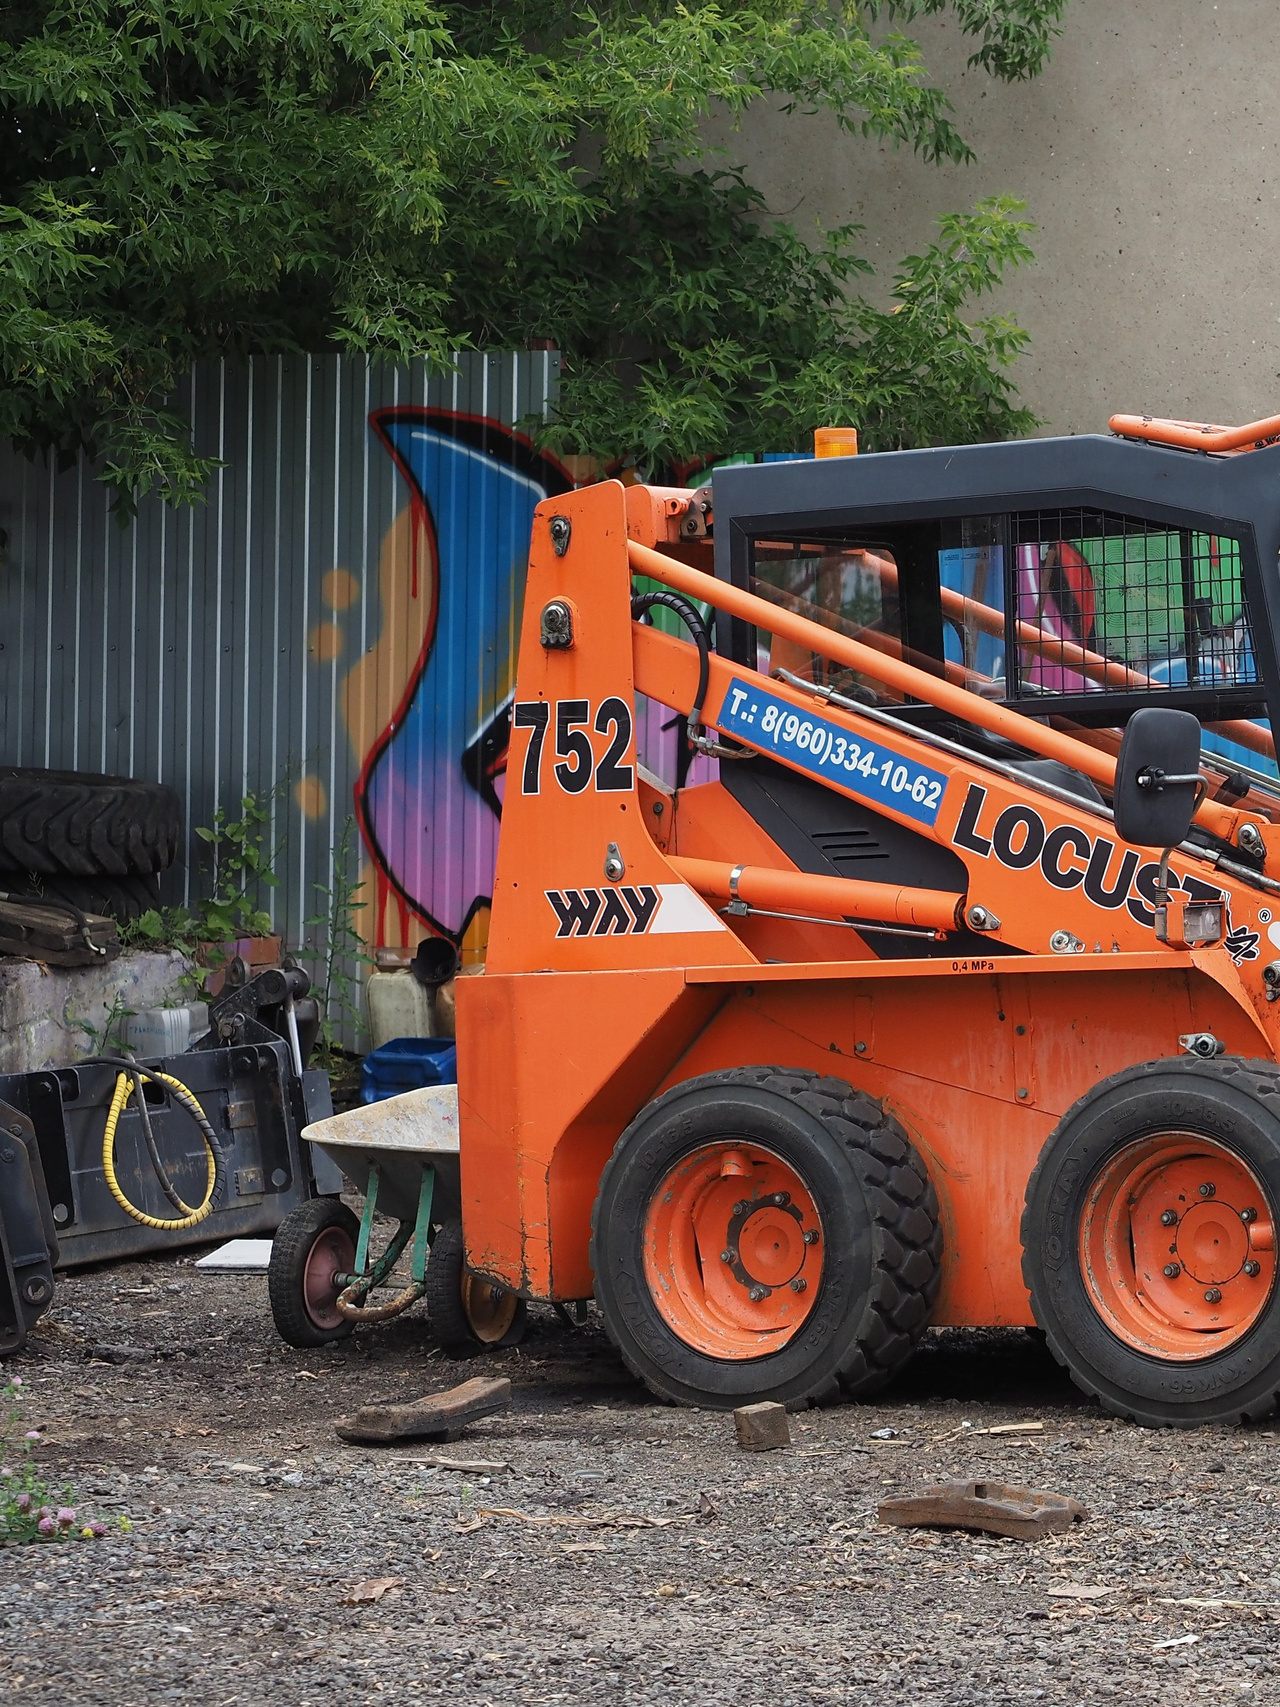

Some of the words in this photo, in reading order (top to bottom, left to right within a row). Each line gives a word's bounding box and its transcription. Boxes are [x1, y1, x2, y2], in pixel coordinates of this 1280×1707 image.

[513, 696, 634, 795] 752
[760, 704, 944, 810] 8(960)334-10-62
[544, 884, 663, 938] WAY
[952, 961, 968, 973] 0,4
[971, 960, 994, 971] MPa
